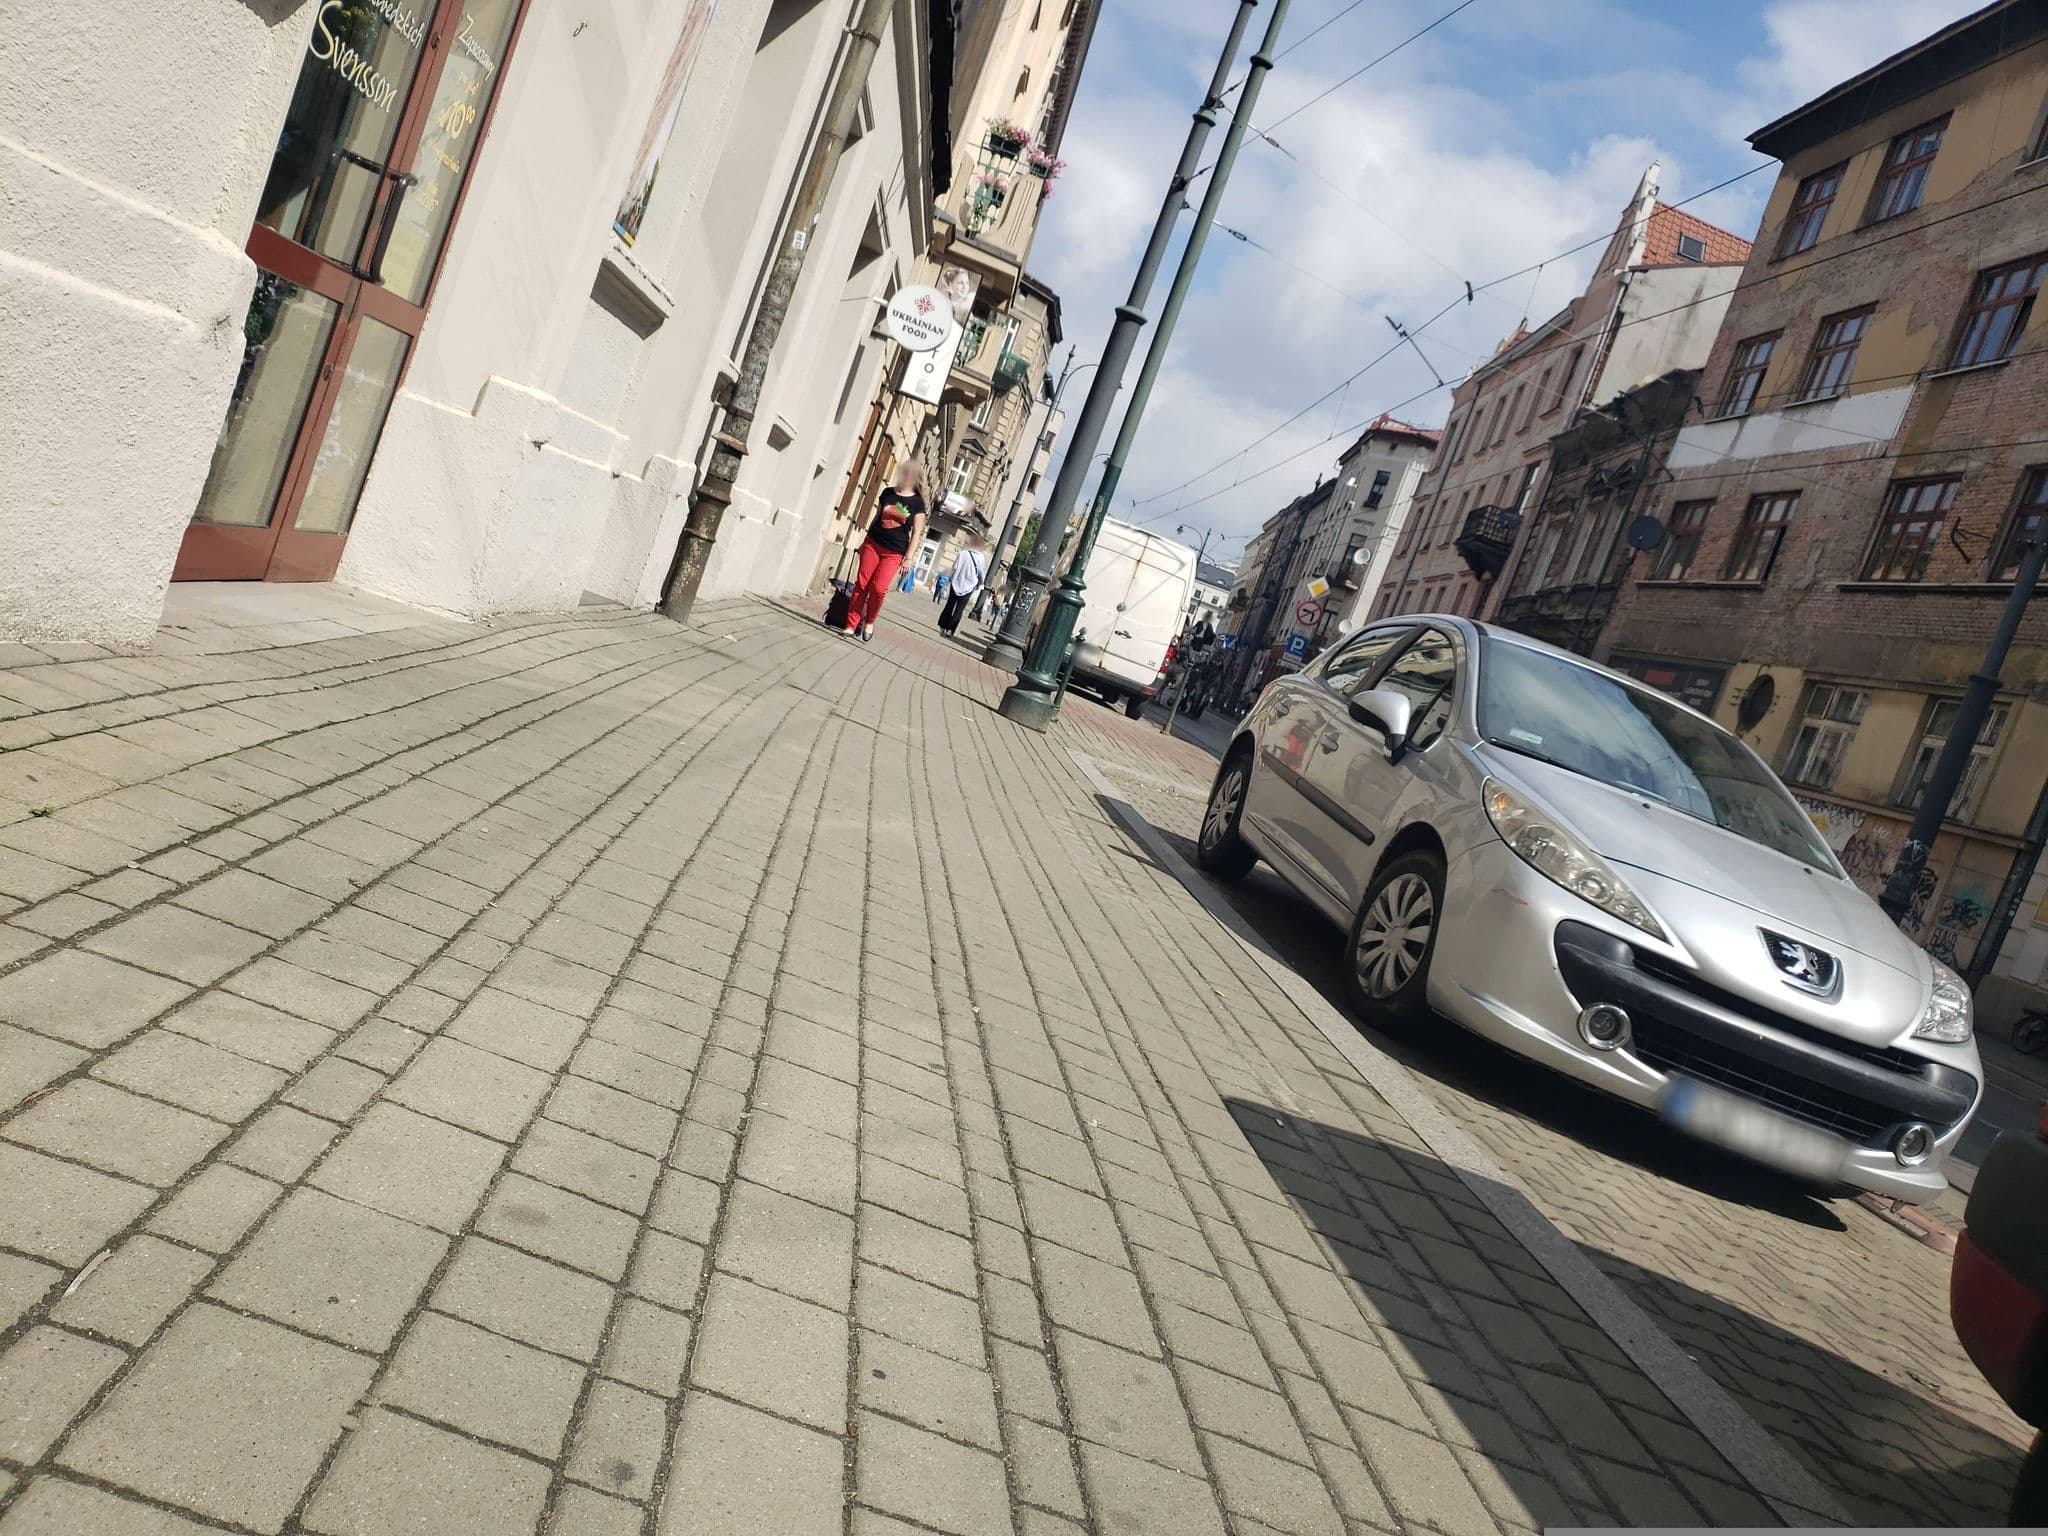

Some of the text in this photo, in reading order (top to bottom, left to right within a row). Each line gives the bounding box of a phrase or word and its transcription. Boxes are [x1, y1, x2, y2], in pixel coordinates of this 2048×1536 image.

[309, 0, 398, 113] Svensson
[892, 309, 945, 335] UKRAINIAN
[902, 324, 928, 340] FOOD
